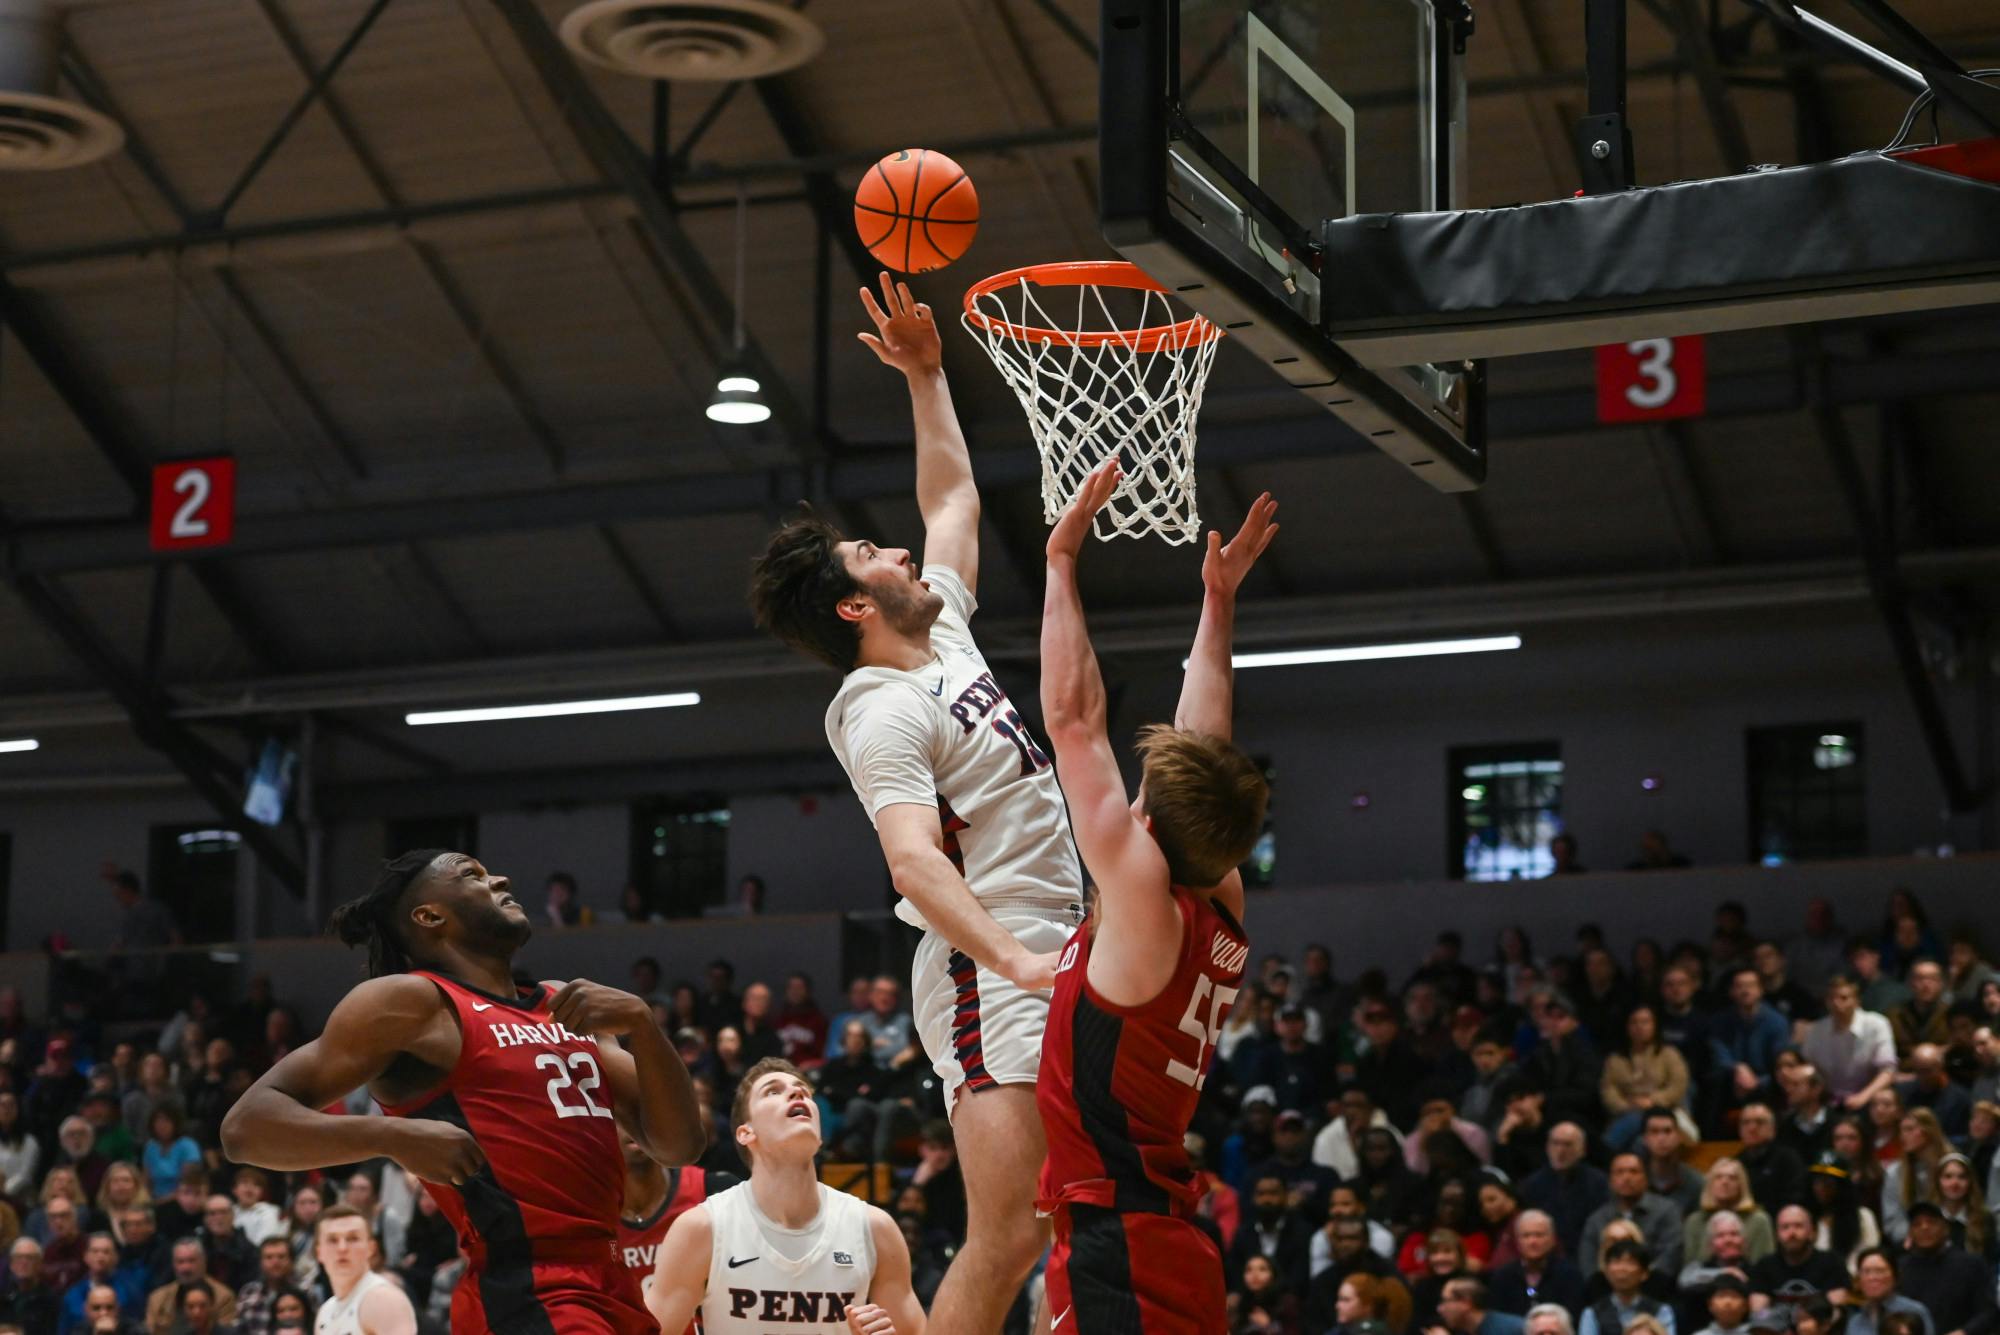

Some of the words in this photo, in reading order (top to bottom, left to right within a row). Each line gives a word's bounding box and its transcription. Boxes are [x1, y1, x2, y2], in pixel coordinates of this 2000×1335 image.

[1625, 338, 1676, 408] 3
[170, 468, 209, 538] 2
[488, 1022, 598, 1048] HARVA
[535, 1051, 614, 1120] 22
[728, 1287, 856, 1323] PENN
